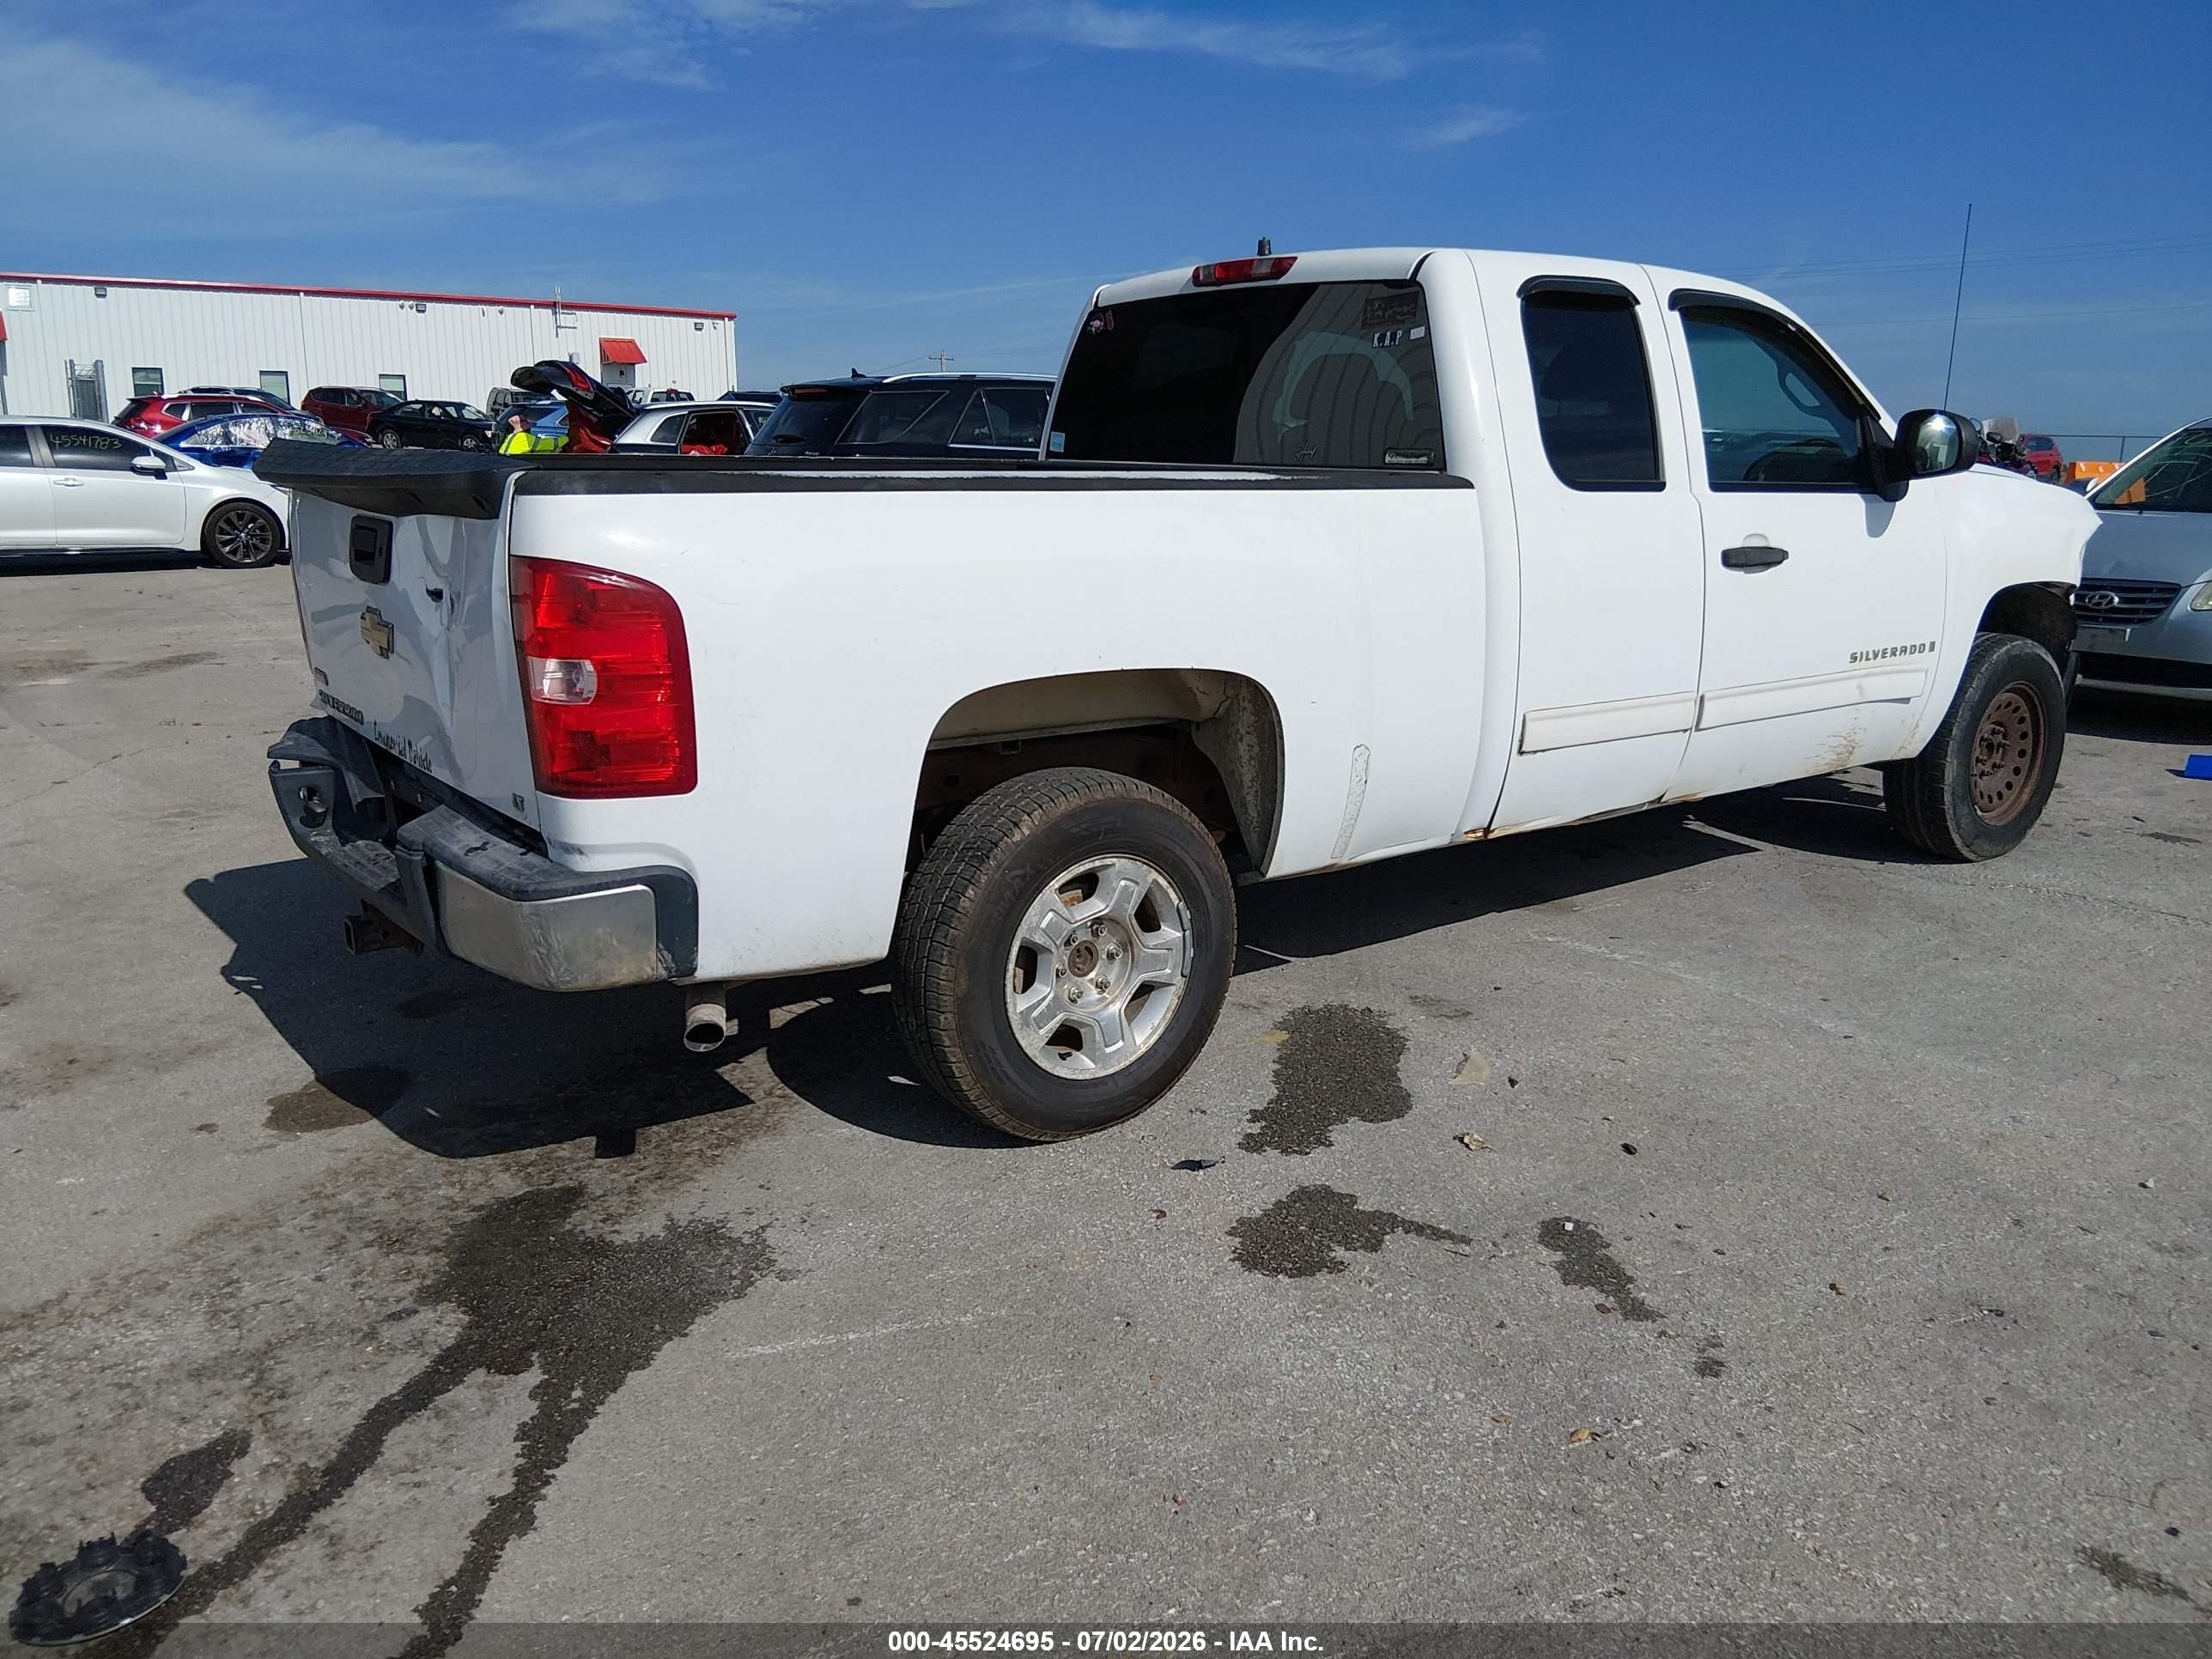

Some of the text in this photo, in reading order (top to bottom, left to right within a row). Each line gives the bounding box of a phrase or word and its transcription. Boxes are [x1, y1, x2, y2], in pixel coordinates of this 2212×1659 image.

[1373, 330, 1402, 348] K.A.P
[50, 434, 122, 450] 45541783
[1849, 642, 1926, 663] SILVERADO
